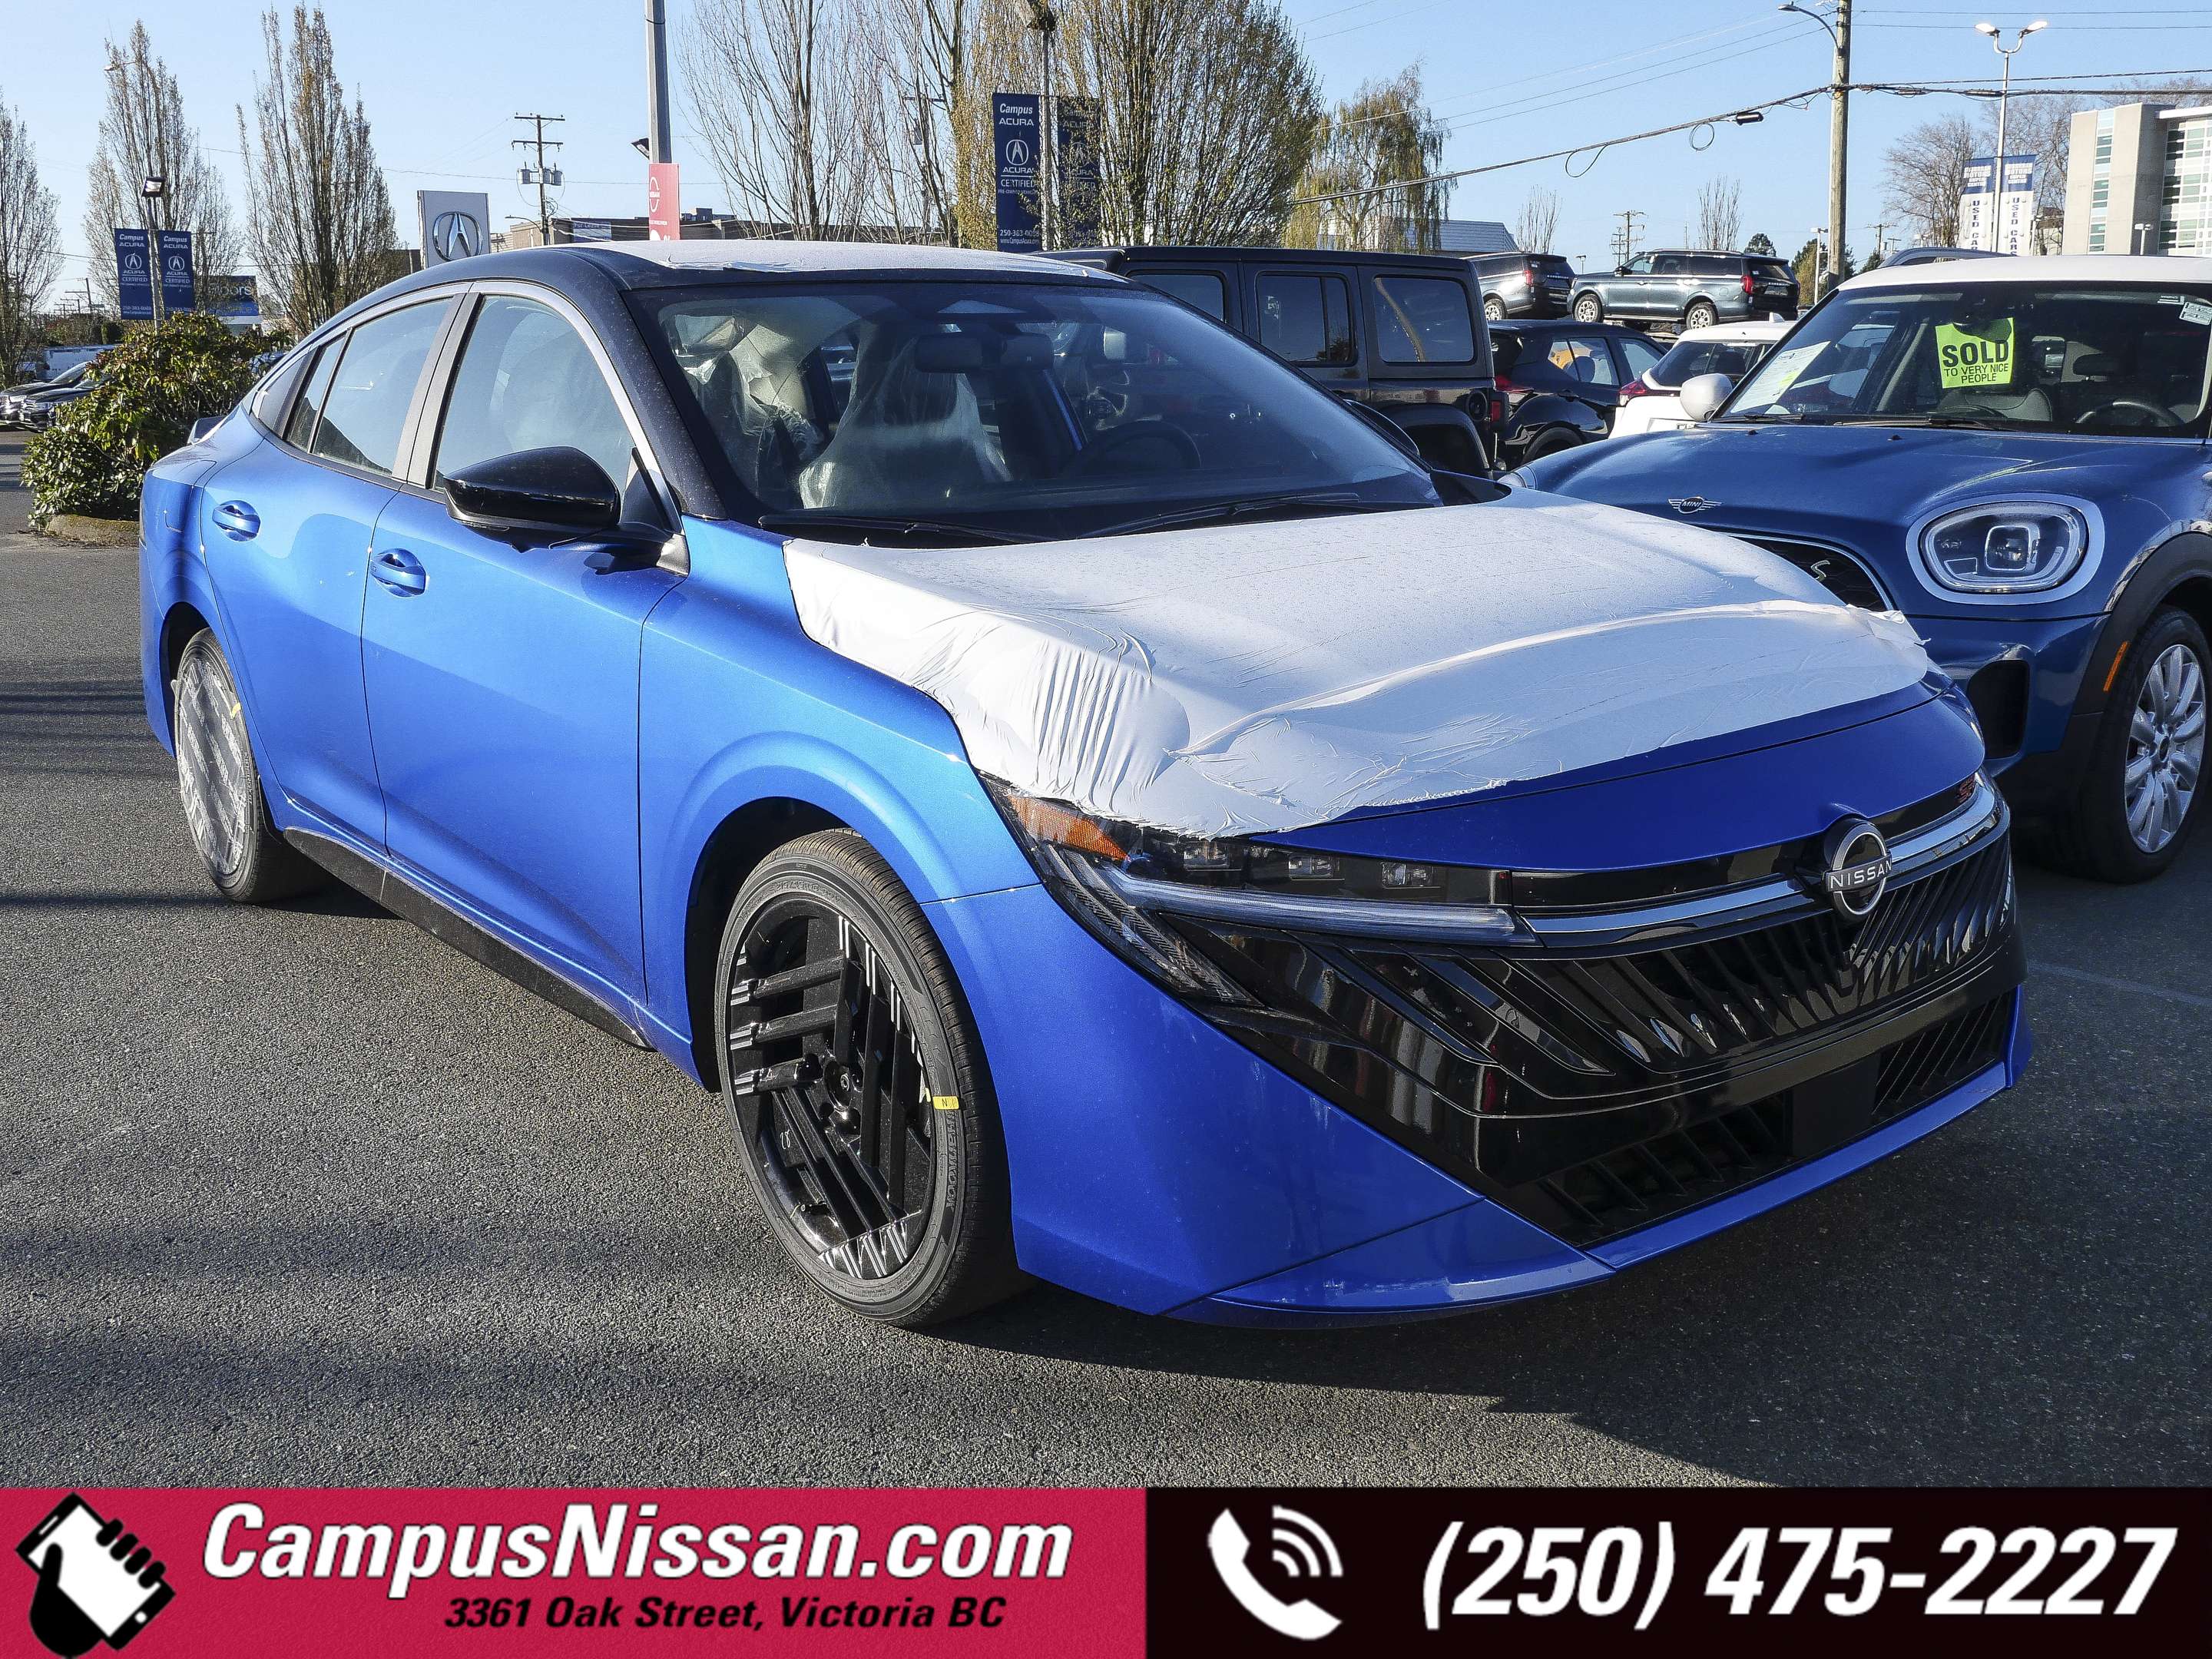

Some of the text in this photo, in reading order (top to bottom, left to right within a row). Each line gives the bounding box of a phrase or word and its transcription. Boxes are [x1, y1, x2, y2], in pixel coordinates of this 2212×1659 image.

[999, 103, 1033, 116] Campus
[998, 118, 1034, 126] ACURA
[1000, 179, 1037, 188] CERTIFIED
[1972, 200, 1980, 227] USED
[2011, 197, 2020, 225] USED
[119, 233, 144, 242] Campus
[164, 235, 187, 243] Campus
[1942, 340, 2009, 368] SOLD
[1944, 363, 2009, 377] TO VERY NICE
[1961, 373, 1997, 384] PEOPLE
[1830, 859, 1892, 889] NISSAN
